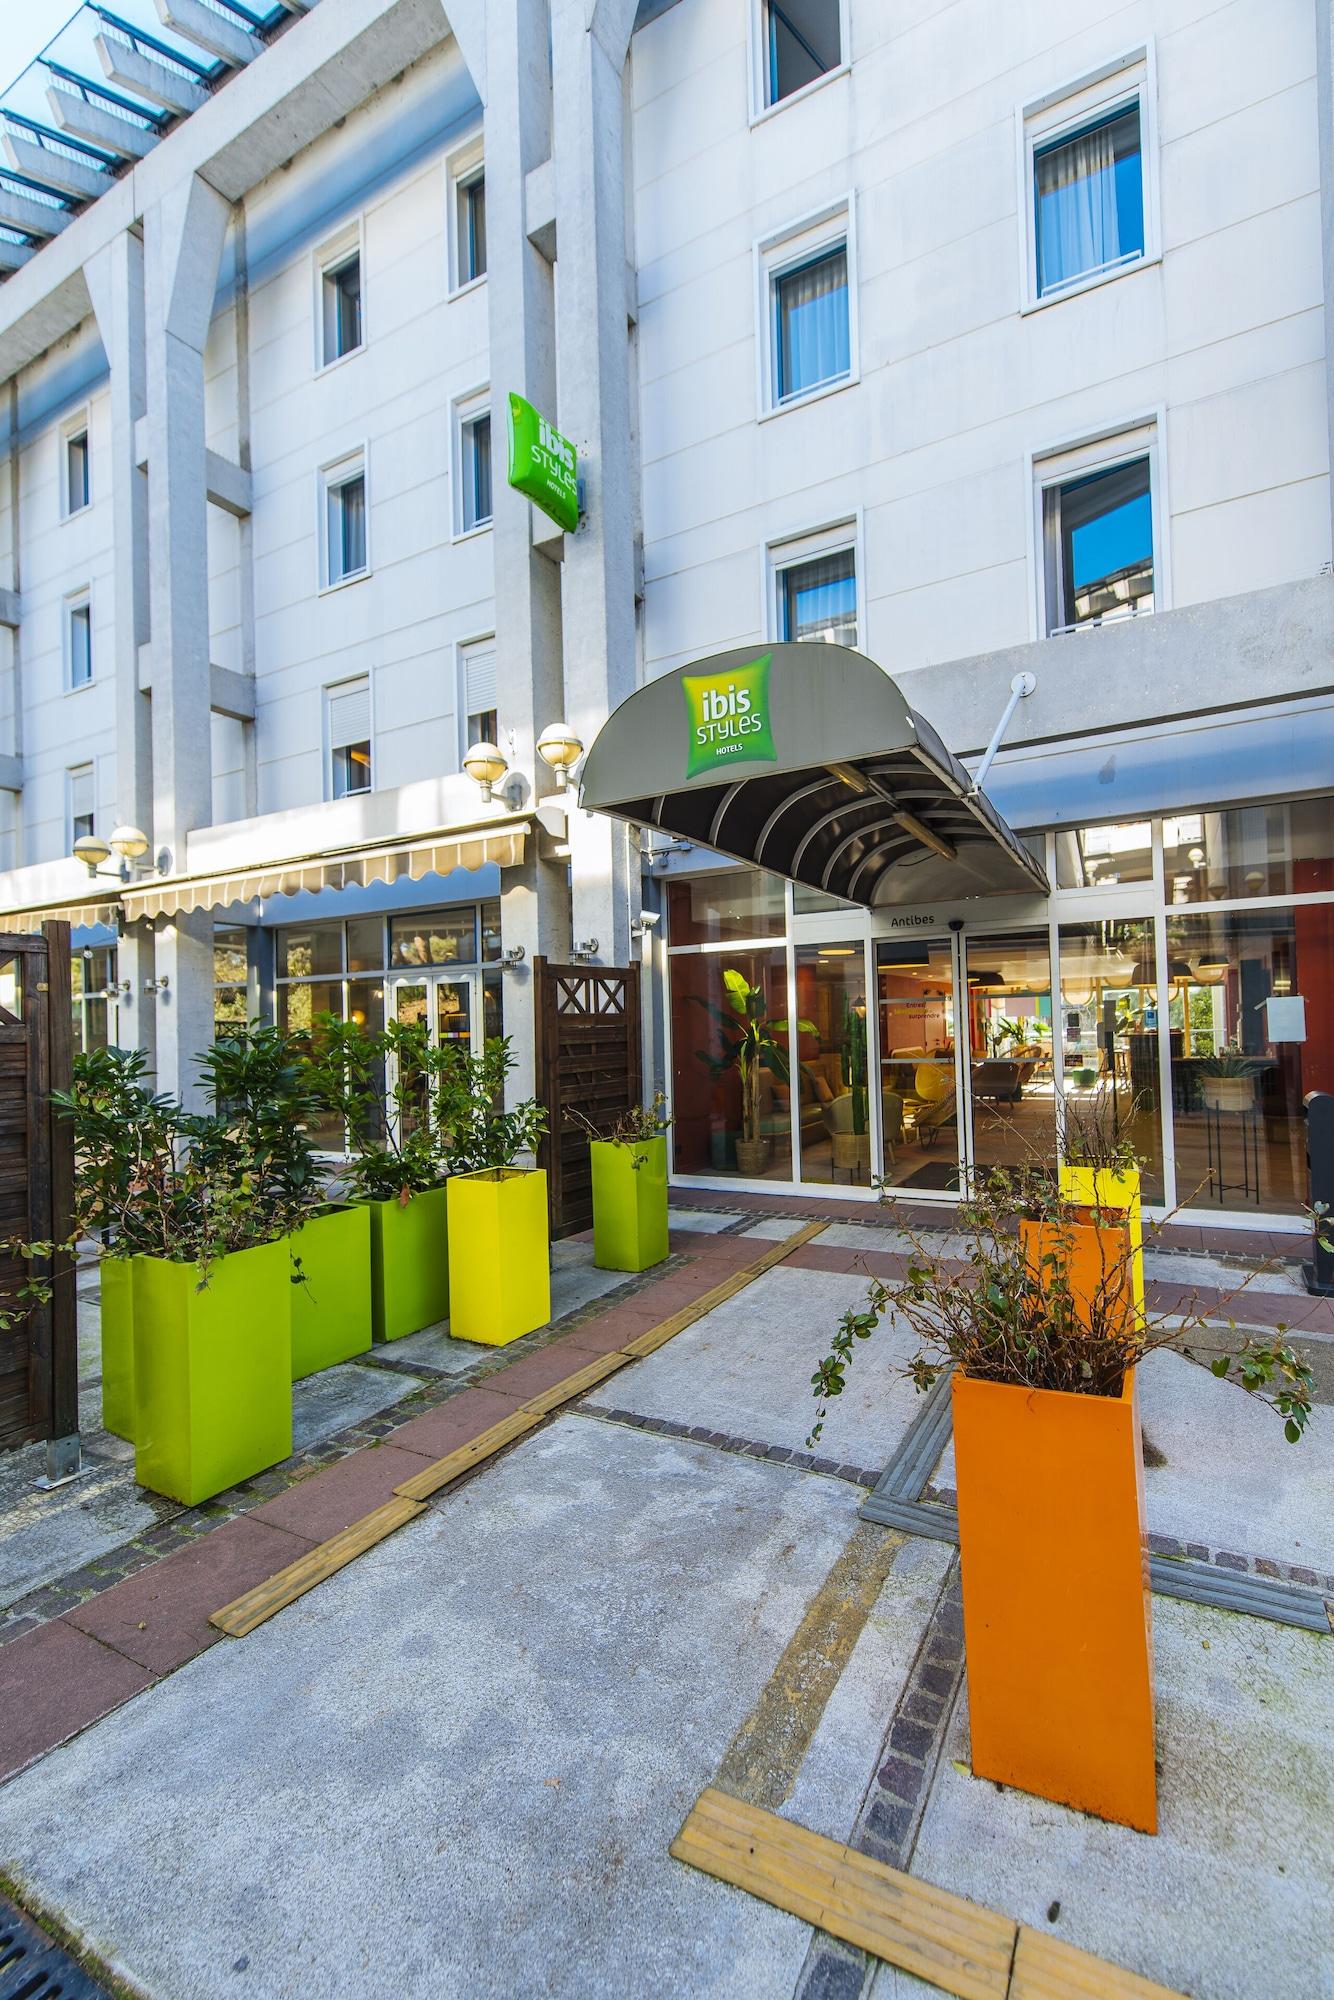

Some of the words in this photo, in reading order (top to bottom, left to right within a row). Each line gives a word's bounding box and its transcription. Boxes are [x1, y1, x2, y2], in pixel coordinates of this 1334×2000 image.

[539, 418, 574, 470] ibis
[547, 480, 566, 499] HOTELS
[702, 684, 751, 721] ibis
[716, 743, 743, 755] HOTELS
[891, 915, 934, 927] Antibes
